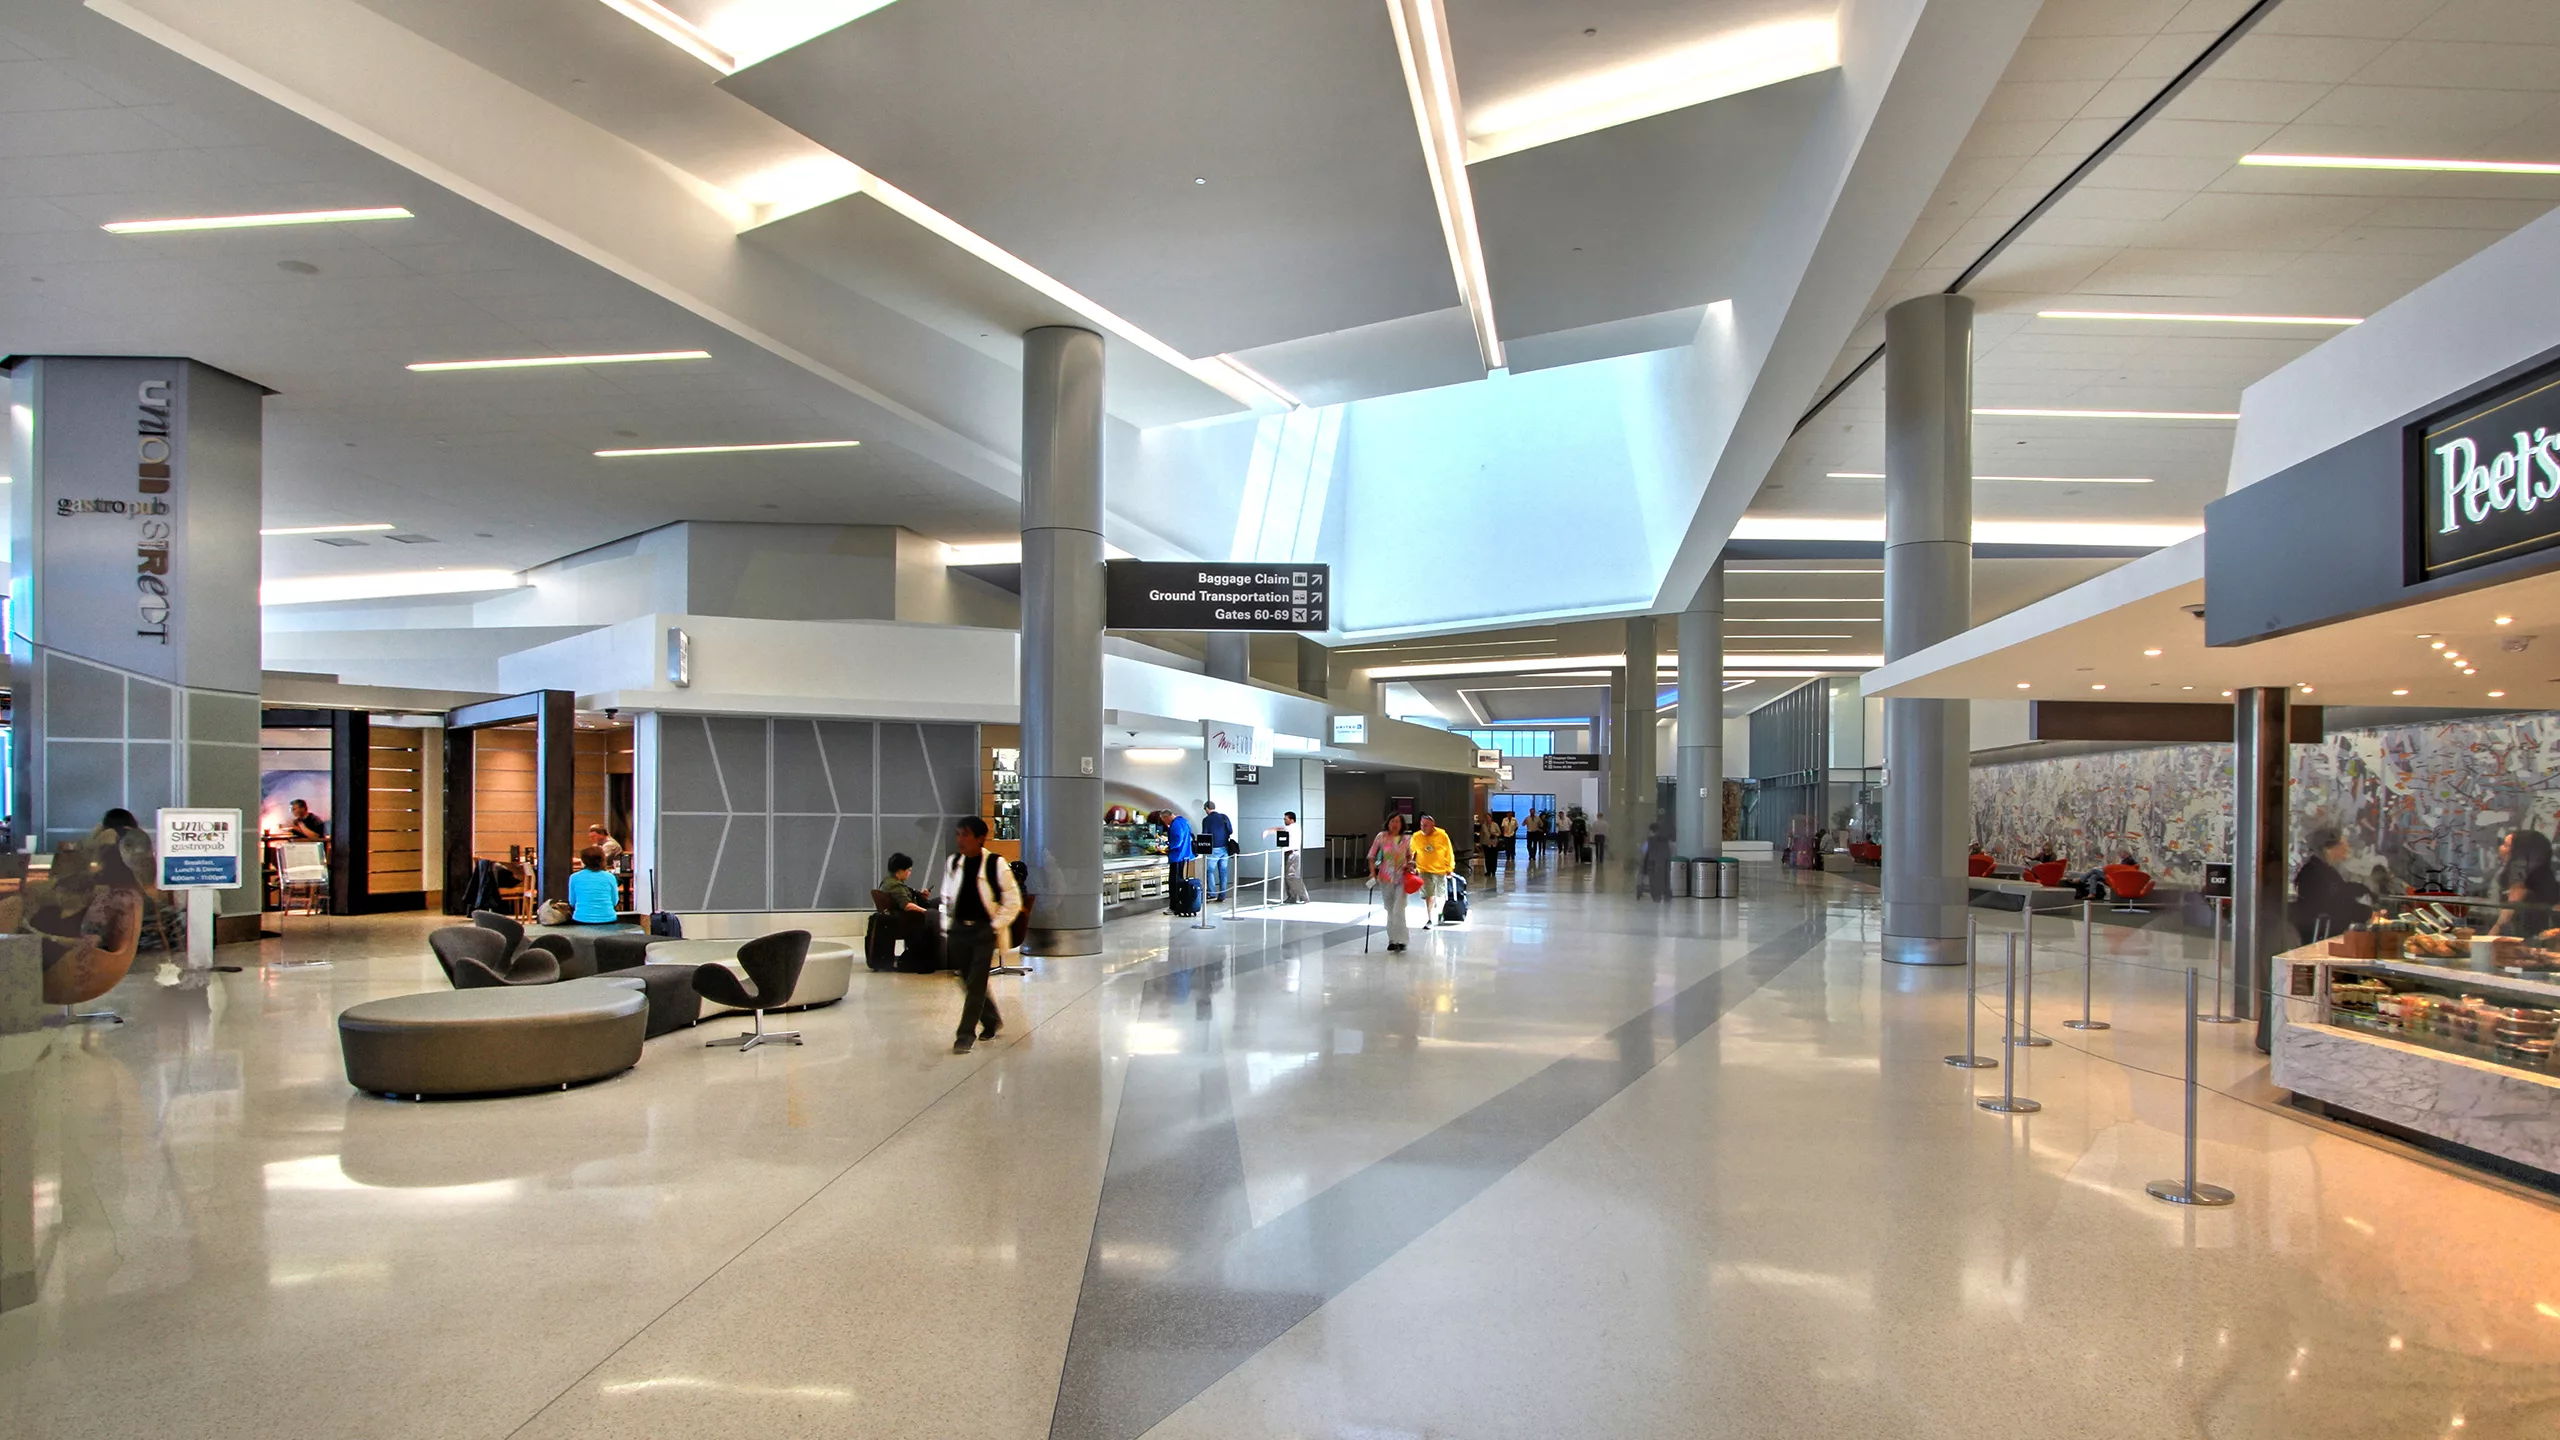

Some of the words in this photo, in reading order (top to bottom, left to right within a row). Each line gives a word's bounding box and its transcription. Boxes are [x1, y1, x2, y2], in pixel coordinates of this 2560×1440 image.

[2434, 426, 2560, 534] Peet's
[57, 497, 170, 520] gastropub
[1198, 573, 1251, 586] Baggage
[1255, 573, 1290, 585] Claim
[1149, 590, 1196, 601] Ground
[1199, 591, 1290, 604] Transportation
[1214, 609, 1251, 620] Gates
[1254, 609, 1290, 620] 60-69
[171, 842, 224, 852] gastropub
